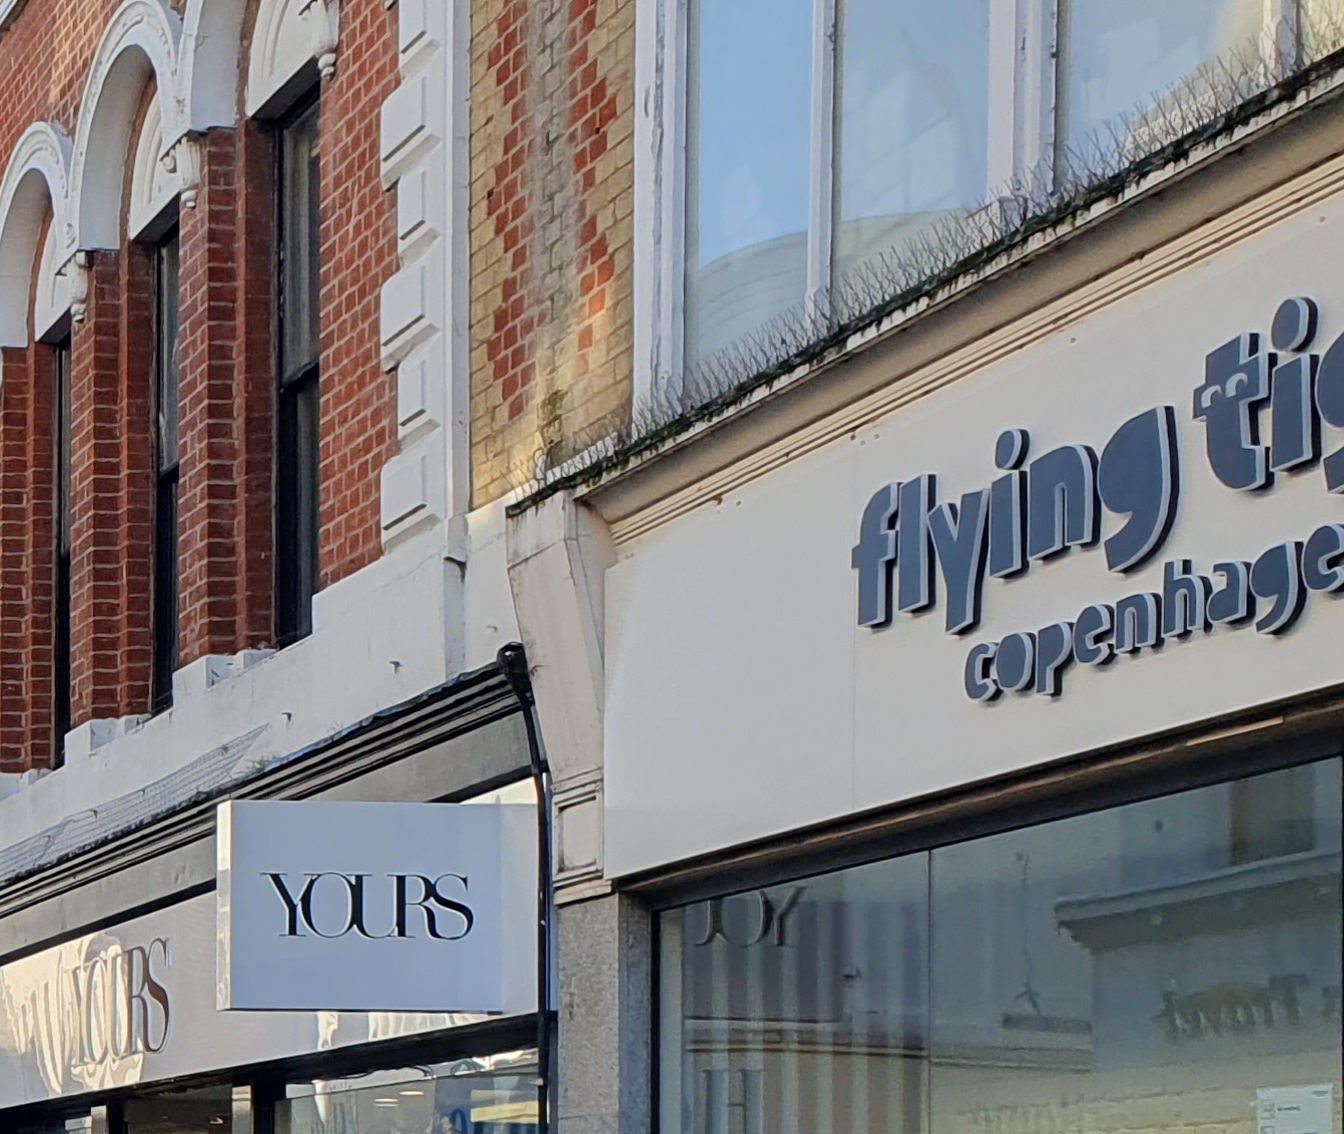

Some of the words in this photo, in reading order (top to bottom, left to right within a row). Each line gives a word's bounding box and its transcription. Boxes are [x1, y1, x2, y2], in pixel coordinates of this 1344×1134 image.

[850, 405, 1182, 636] flying
[259, 871, 474, 941] YOURS
[64, 937, 171, 1068] YOURS
